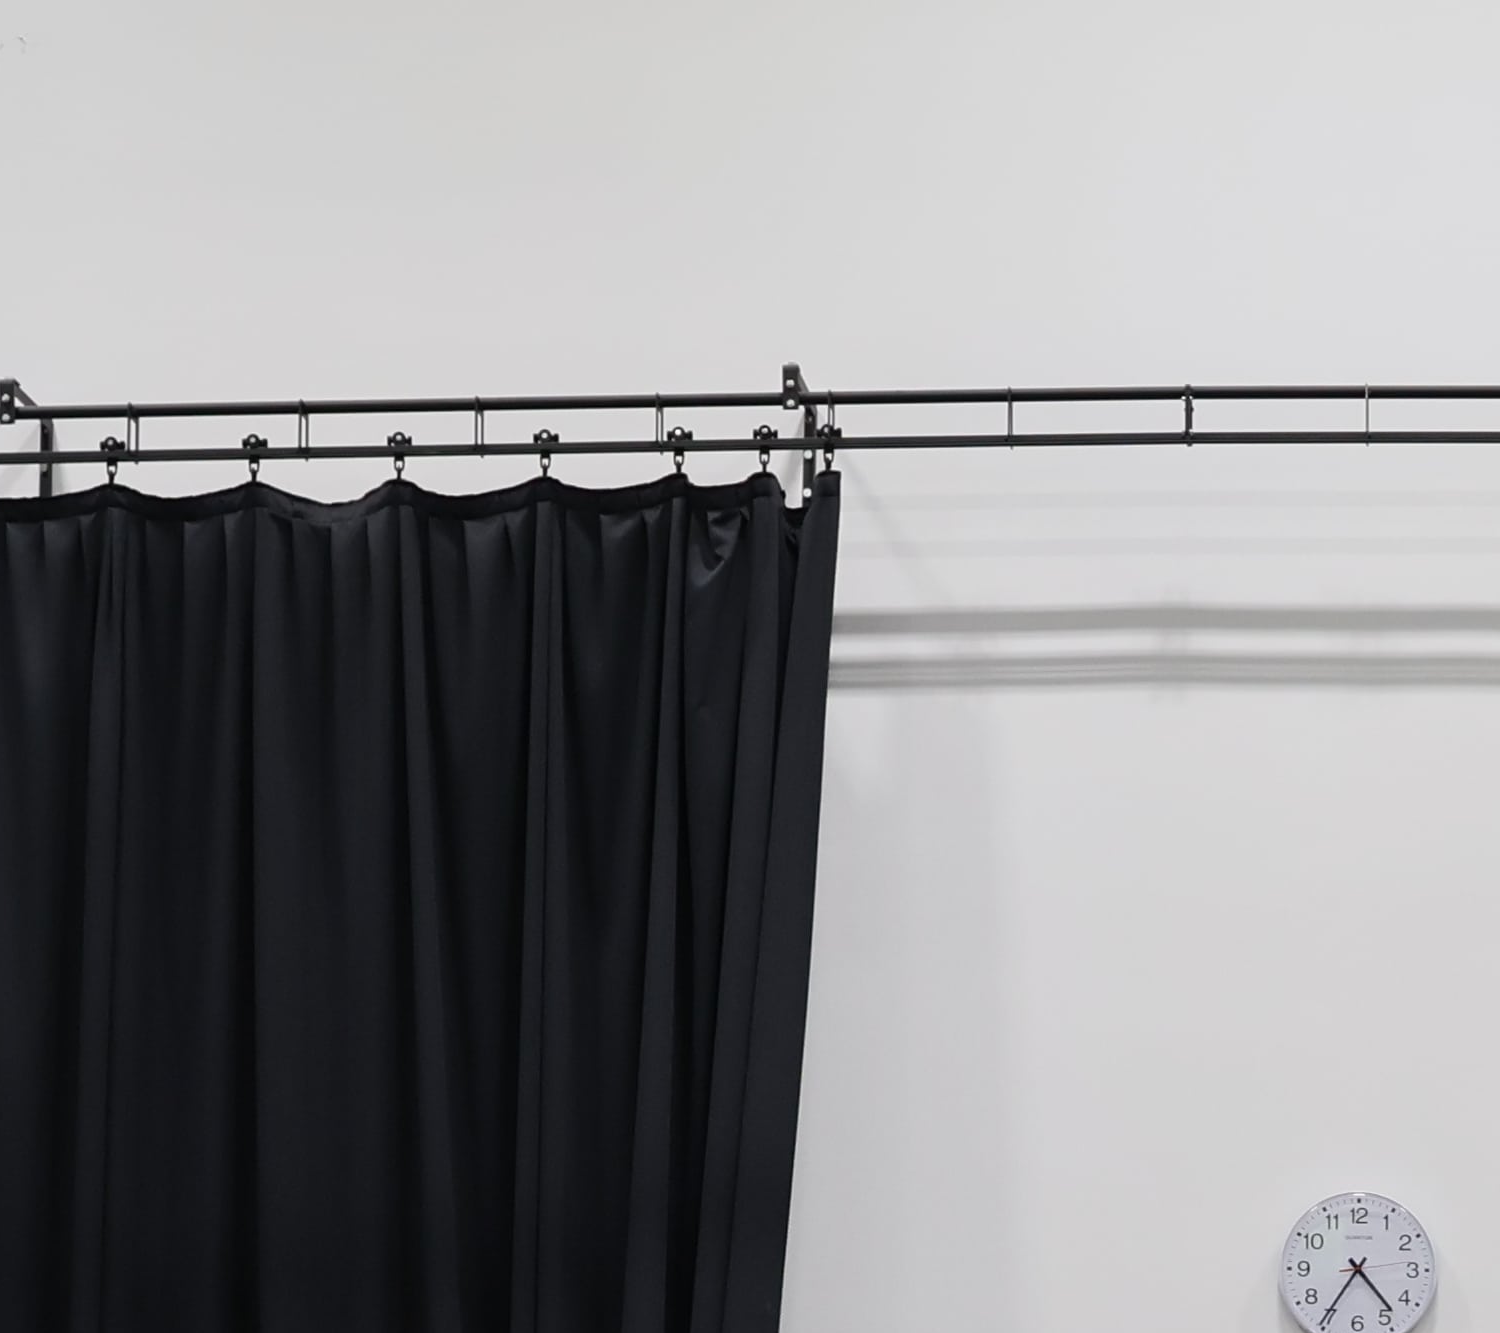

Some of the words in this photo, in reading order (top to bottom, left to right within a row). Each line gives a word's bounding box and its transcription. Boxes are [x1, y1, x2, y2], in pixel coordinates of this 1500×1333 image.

[1326, 1214, 1339, 1230] 11
[1350, 1208, 1368, 1225] 12
[1383, 1215, 1389, 1231] 1
[1304, 1233, 1324, 1250] 10
[1399, 1235, 1412, 1251] 2
[1297, 1261, 1310, 1277] 9
[1406, 1262, 1419, 1278] 3
[1305, 1289, 1318, 1305] 8
[1398, 1291, 1411, 1306] 4
[1351, 1315, 1364, 1332] 6
[1379, 1309, 1392, 1326] 5
